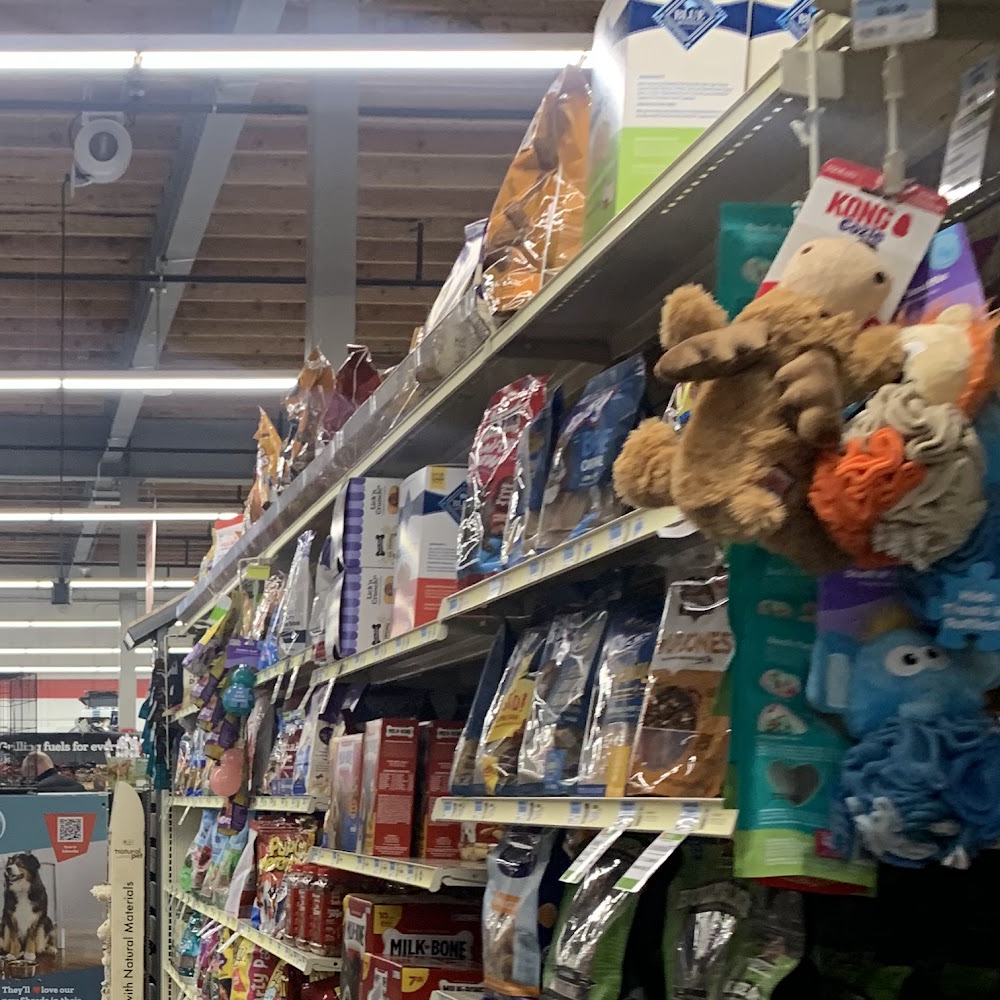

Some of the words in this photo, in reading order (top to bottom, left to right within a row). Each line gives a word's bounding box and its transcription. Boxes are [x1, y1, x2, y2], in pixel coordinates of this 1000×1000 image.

[826, 190, 896, 232] KONG
[43, 741, 71, 752] fuels
[72, 741, 89, 752] for
[122, 881, 134, 933] Materials
[123, 938, 134, 979] Natural
[390, 938, 468, 960] MILK-BONE
[1, 985, 31, 996] They'll
[41, 985, 57, 993] love
